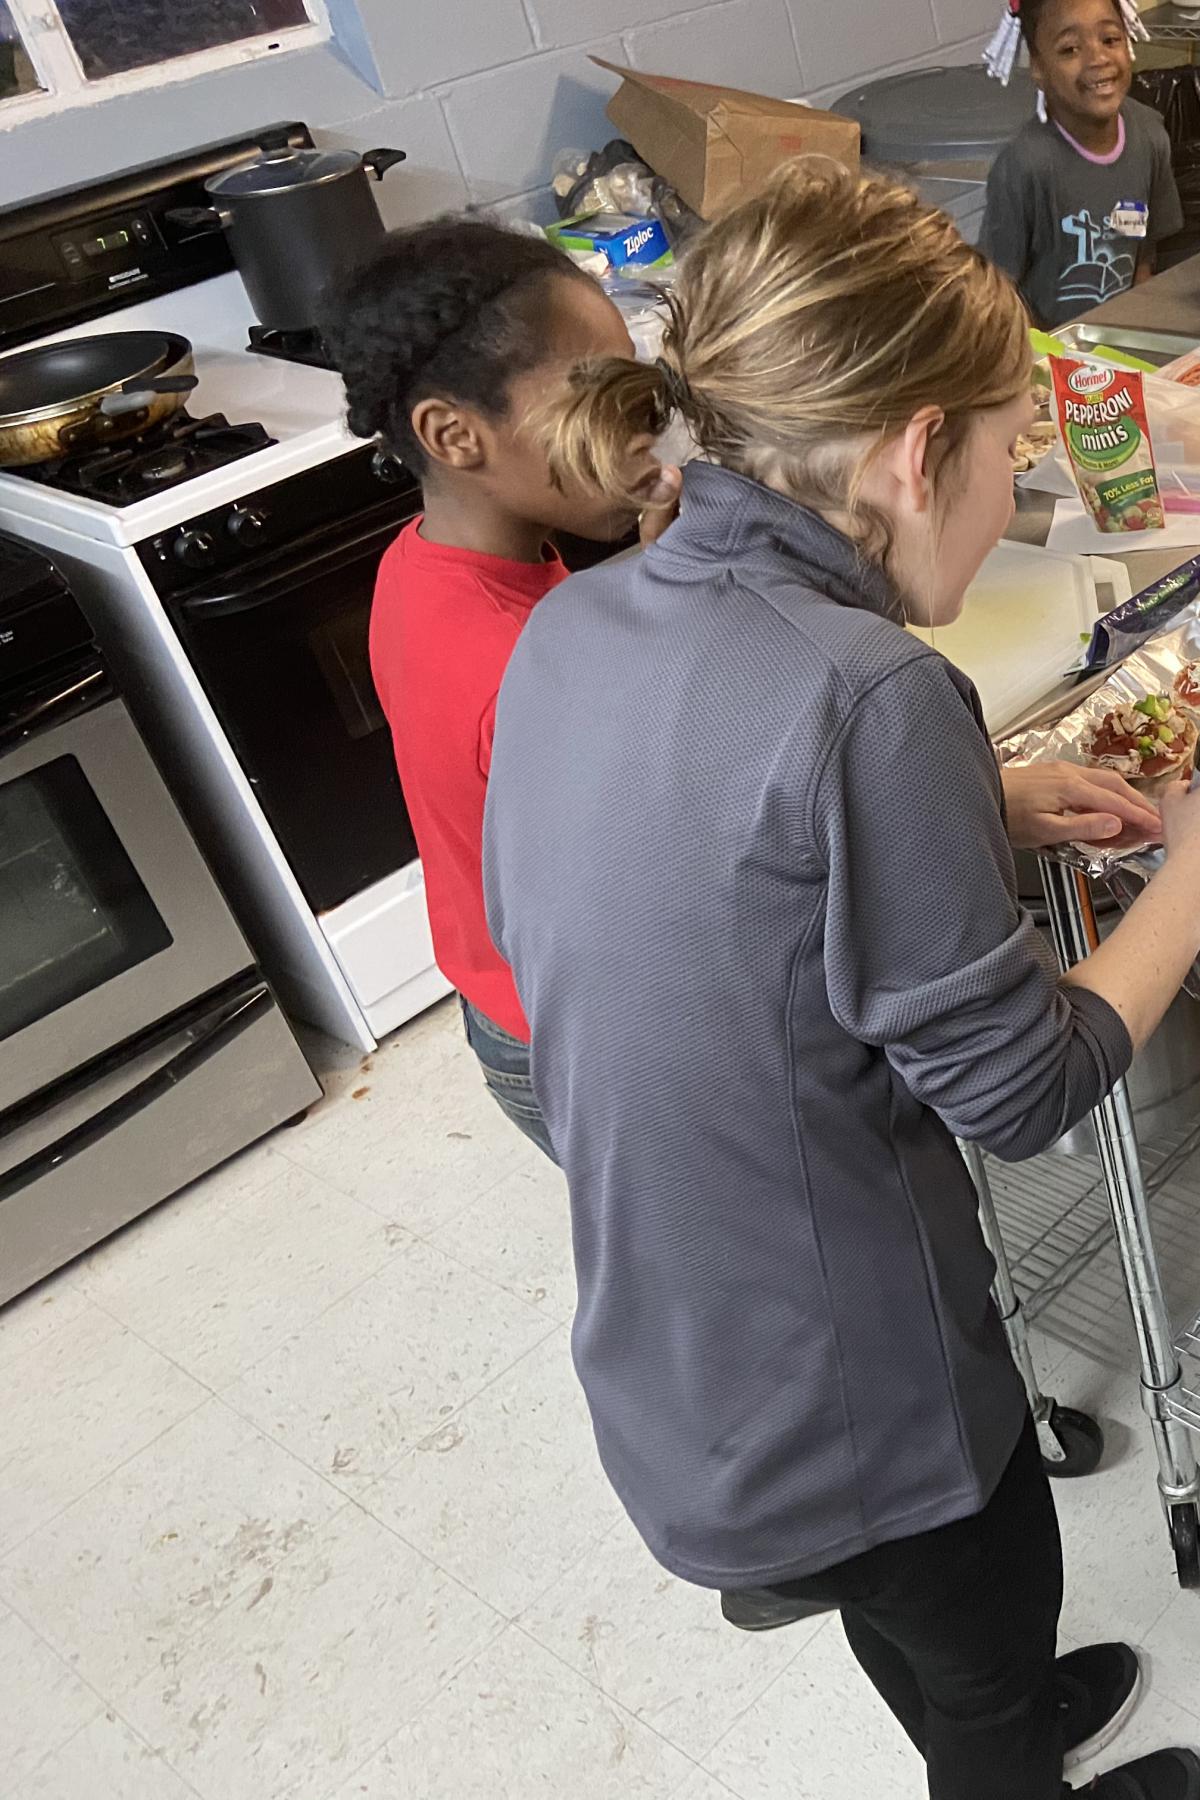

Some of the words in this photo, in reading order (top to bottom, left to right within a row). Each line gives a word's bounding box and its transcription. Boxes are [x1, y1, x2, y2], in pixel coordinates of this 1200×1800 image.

[623, 227, 654, 257] Ziploc
[1075, 371, 1107, 389] Hormel
[1065, 387, 1133, 425] PEPPERONI
[1082, 425, 1128, 451] minis
[1103, 487, 1121, 500] 70%
[1121, 481, 1139, 493] Less
[1140, 475, 1154, 485] Fat
